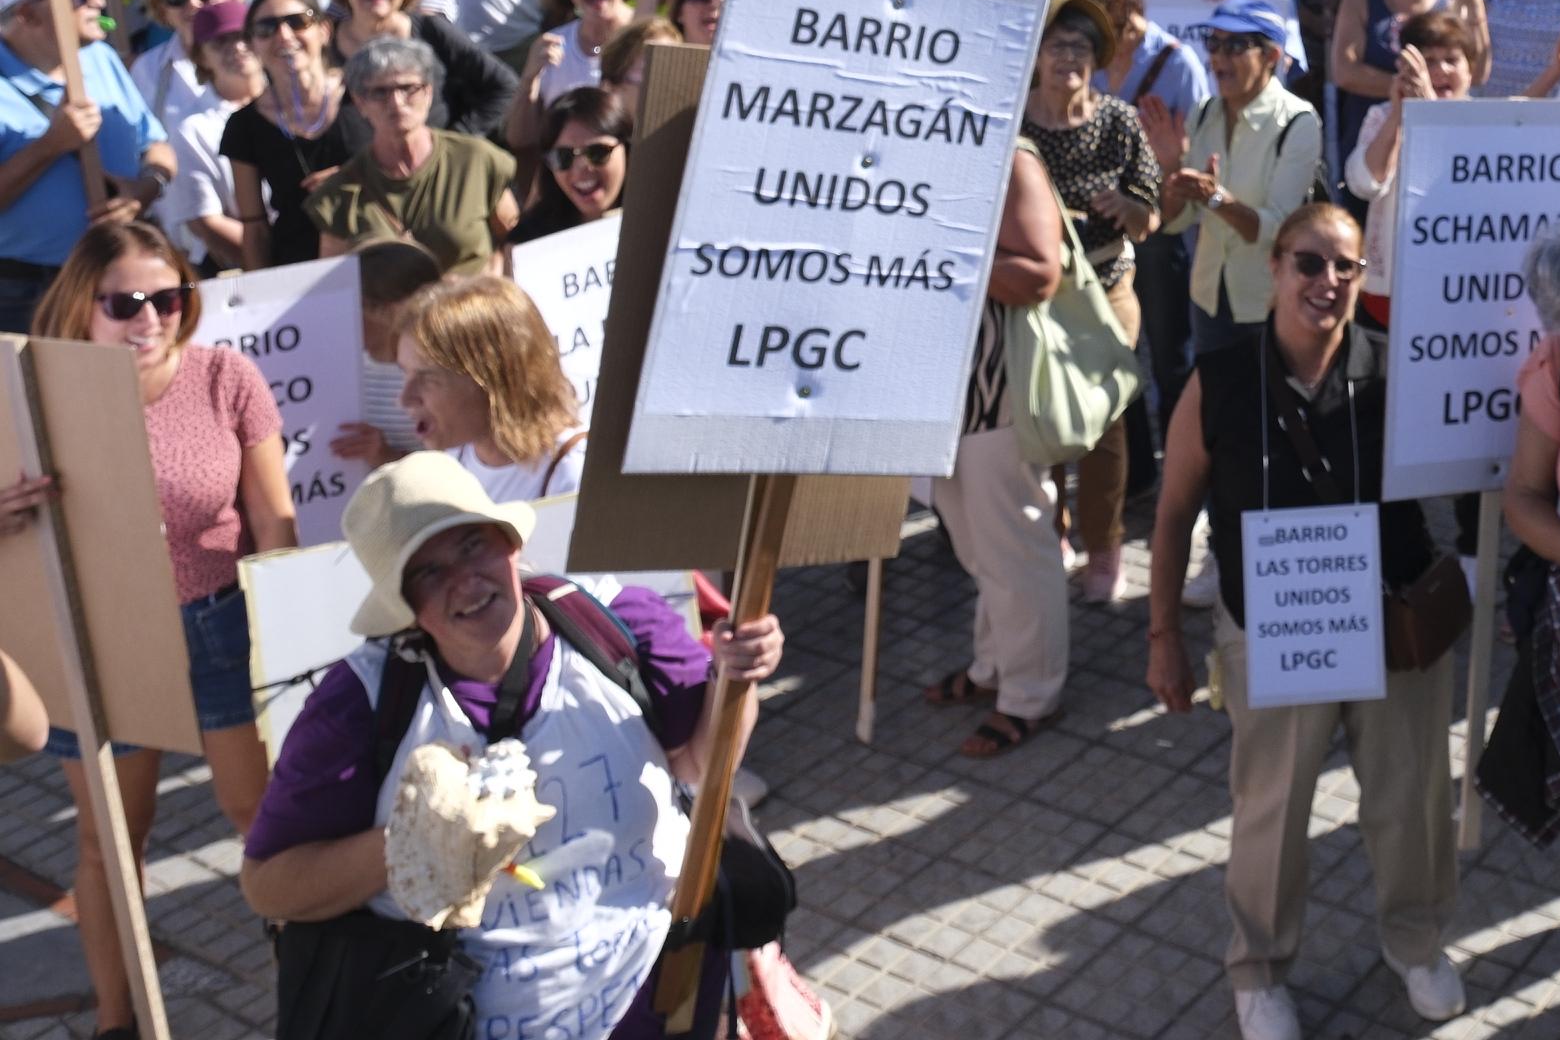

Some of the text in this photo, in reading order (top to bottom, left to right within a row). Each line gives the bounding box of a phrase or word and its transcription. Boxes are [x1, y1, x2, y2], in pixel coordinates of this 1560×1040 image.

[789, 6, 961, 65] BARRIO
[720, 81, 989, 148] MARZAGÁN
[753, 167, 931, 219] UNIDOS
[689, 242, 955, 292] SOMOS MÁS
[1442, 273, 1524, 304] UNID
[727, 323, 867, 373] LPGC
[1409, 330, 1518, 362] SOMOS
[1444, 388, 1521, 426] LPG
[1274, 524, 1348, 544] BARRIO
[1256, 554, 1369, 577] LAS TORRES
[1275, 586, 1352, 608] UNIDOS
[1258, 613, 1370, 639] SOMOS MÁS
[1281, 649, 1339, 672] LPGC
